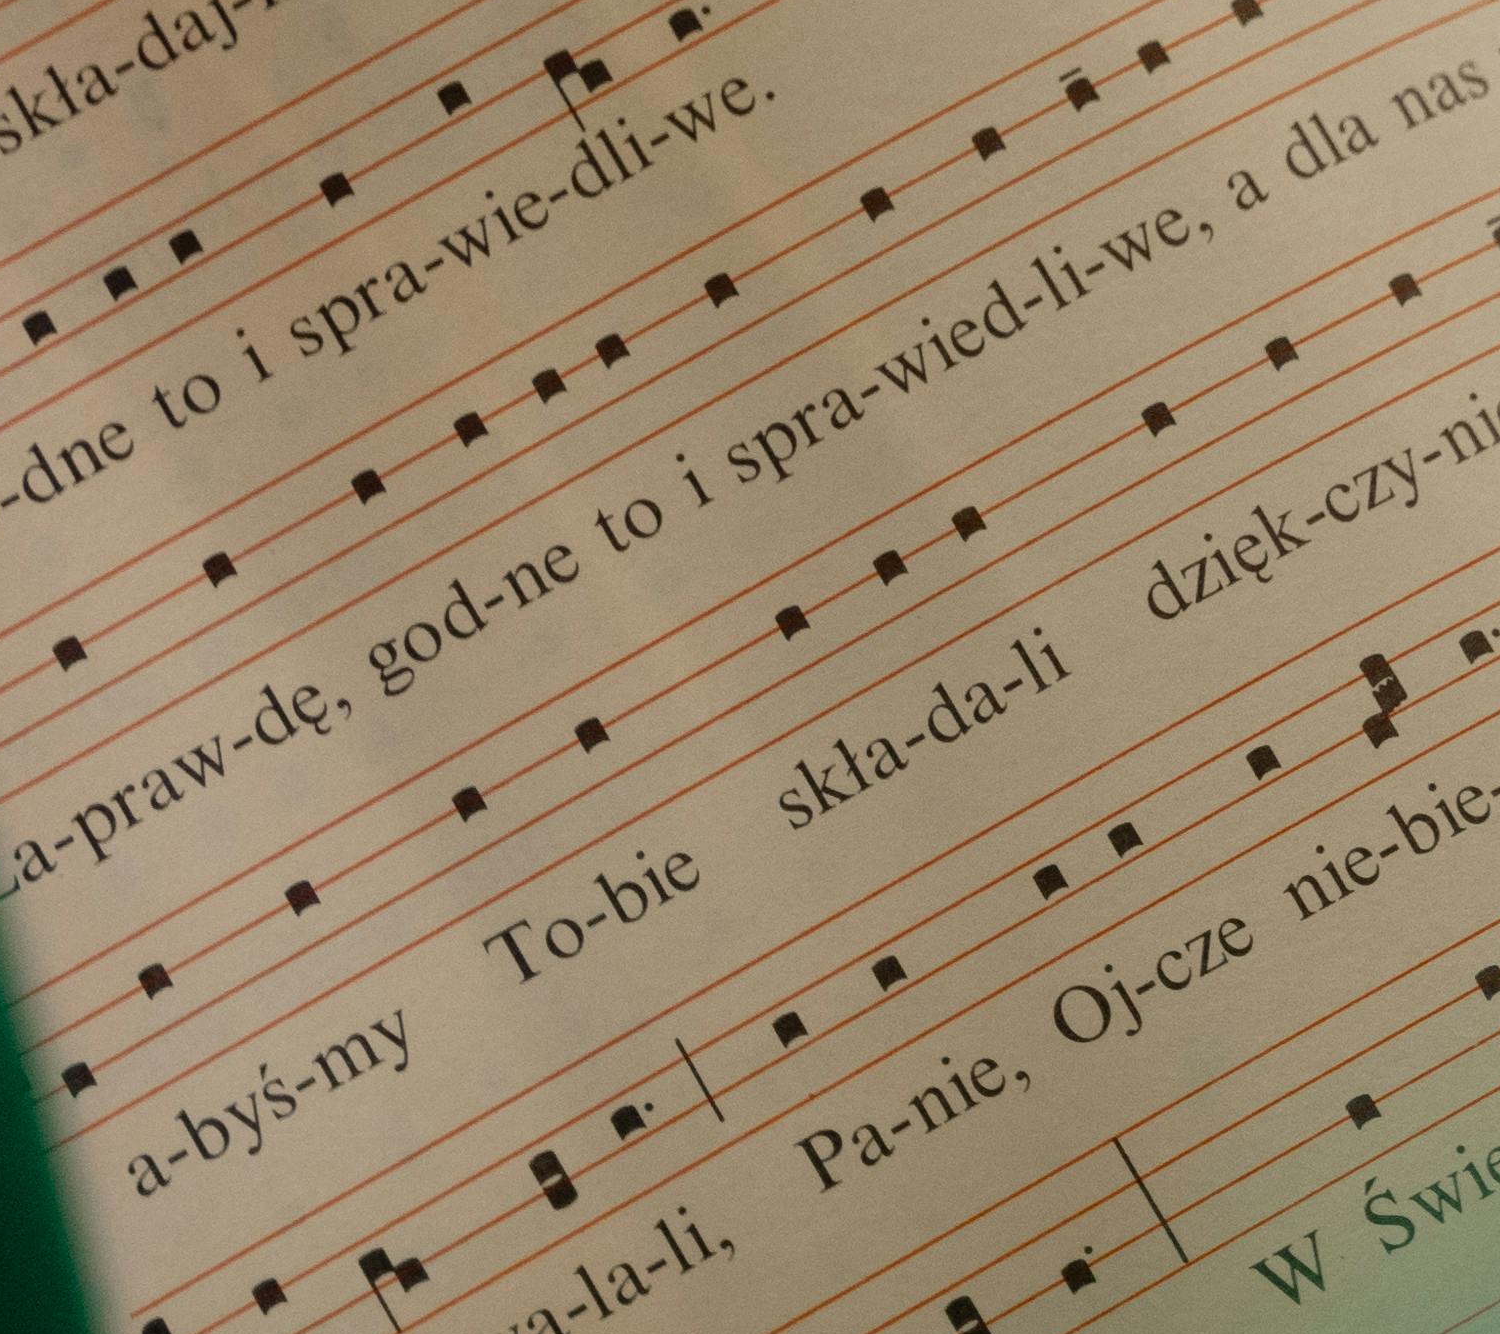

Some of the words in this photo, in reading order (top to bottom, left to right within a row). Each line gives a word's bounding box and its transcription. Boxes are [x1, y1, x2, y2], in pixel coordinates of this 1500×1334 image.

[152, 373, 221, 431] to
[235, 329, 273, 383] i
[289, 77, 776, 358] spra-wie-dli-we.
[367, 540, 580, 697] god-ne
[594, 496, 664, 554] to
[675, 453, 715, 507] i
[726, 206, 1216, 485] spra-wied-li-we,
[1227, 169, 1269, 212] a
[1284, 111, 1380, 182] dla
[1392, 58, 1490, 133] nas
[127, 1009, 413, 1197] a-byś-my
[483, 848, 700, 984] To-bie
[778, 626, 1072, 830] skła-da-li
[795, 1054, 1031, 1193] Pa-nie,
[1054, 915, 1255, 1043] Oj-cze
[1249, 1230, 1329, 1307] W
